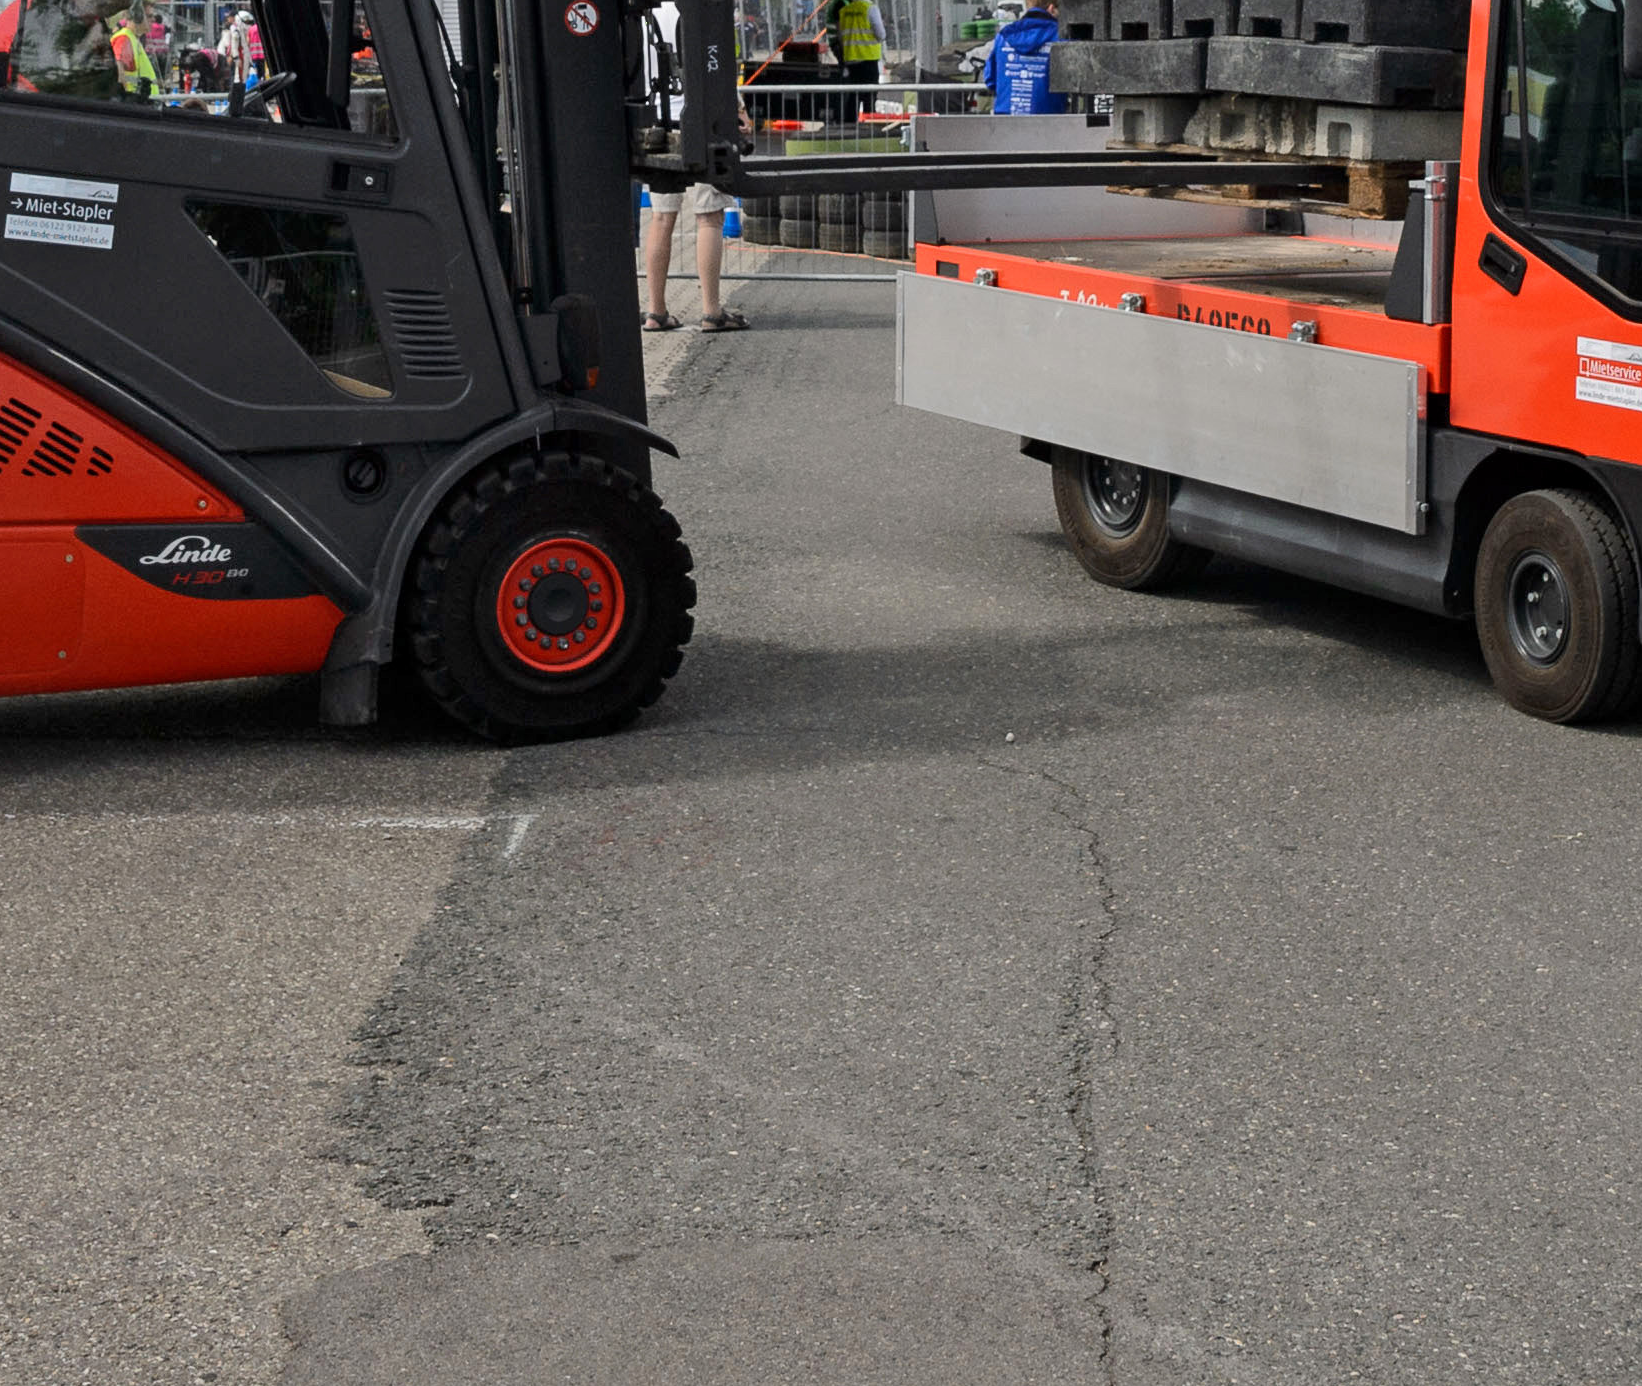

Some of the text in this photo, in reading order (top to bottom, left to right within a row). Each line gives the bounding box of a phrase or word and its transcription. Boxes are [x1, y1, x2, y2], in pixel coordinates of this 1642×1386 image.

[25, 197, 114, 221] Miet-Stapler
[1590, 359, 1642, 382] Mietservice
[139, 535, 232, 565] Linde
